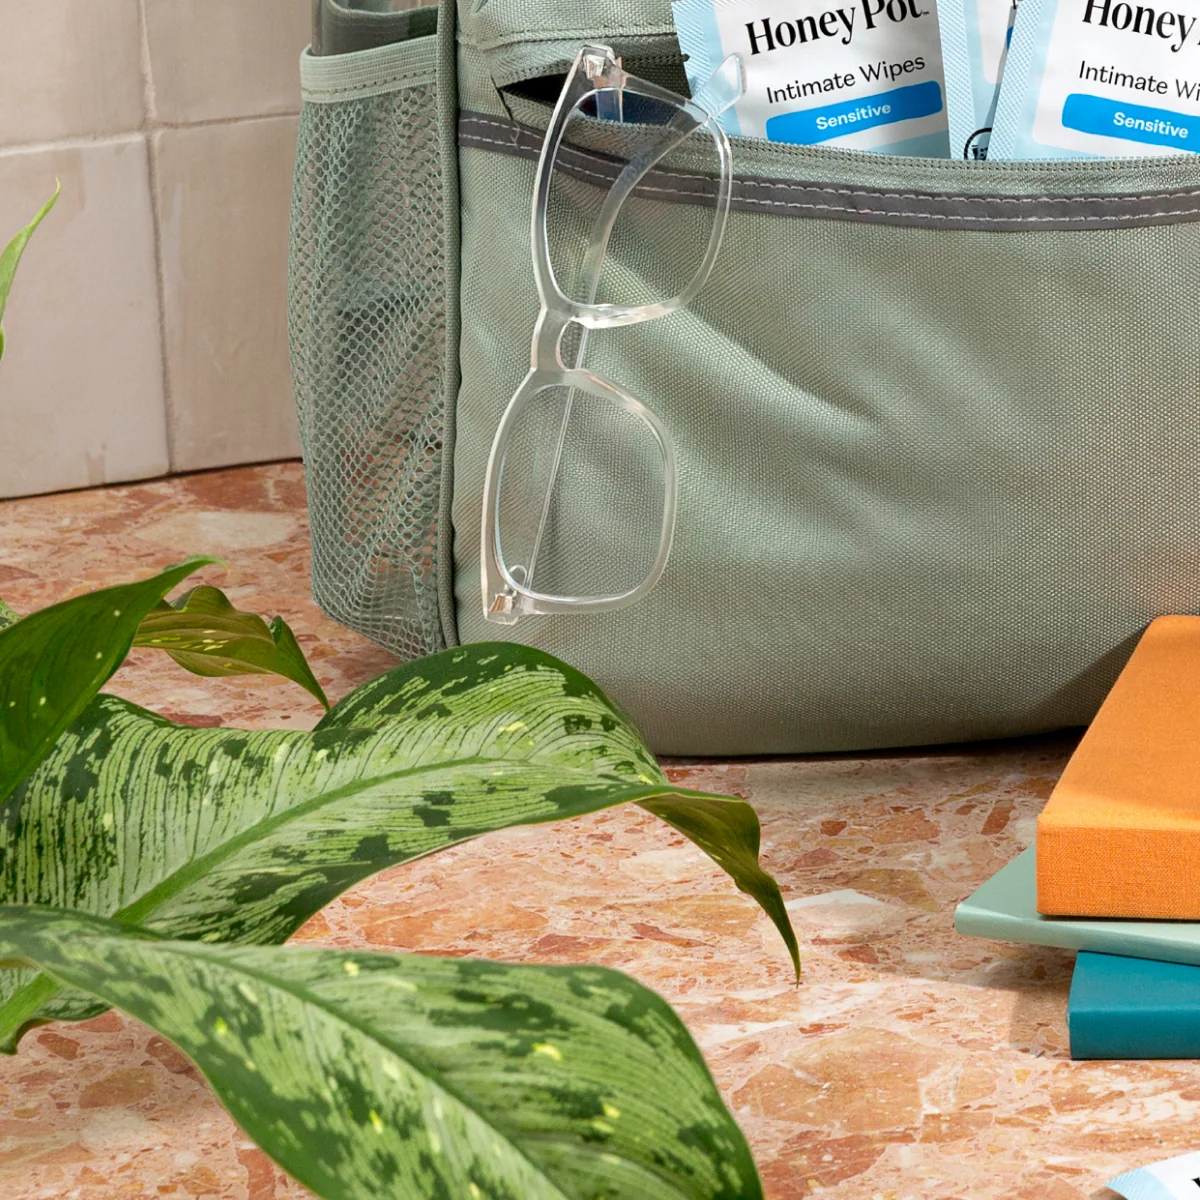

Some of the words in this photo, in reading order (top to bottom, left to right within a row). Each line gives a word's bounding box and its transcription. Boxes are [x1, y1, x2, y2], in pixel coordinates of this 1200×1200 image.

[745, 7, 856, 55] Honey
[766, 73, 856, 104] Intimate
[859, 56, 926, 82] Wipes
[1079, 61, 1168, 95] Intimate
[816, 104, 892, 130] Sensitive
[1113, 112, 1189, 138] Sensitive
